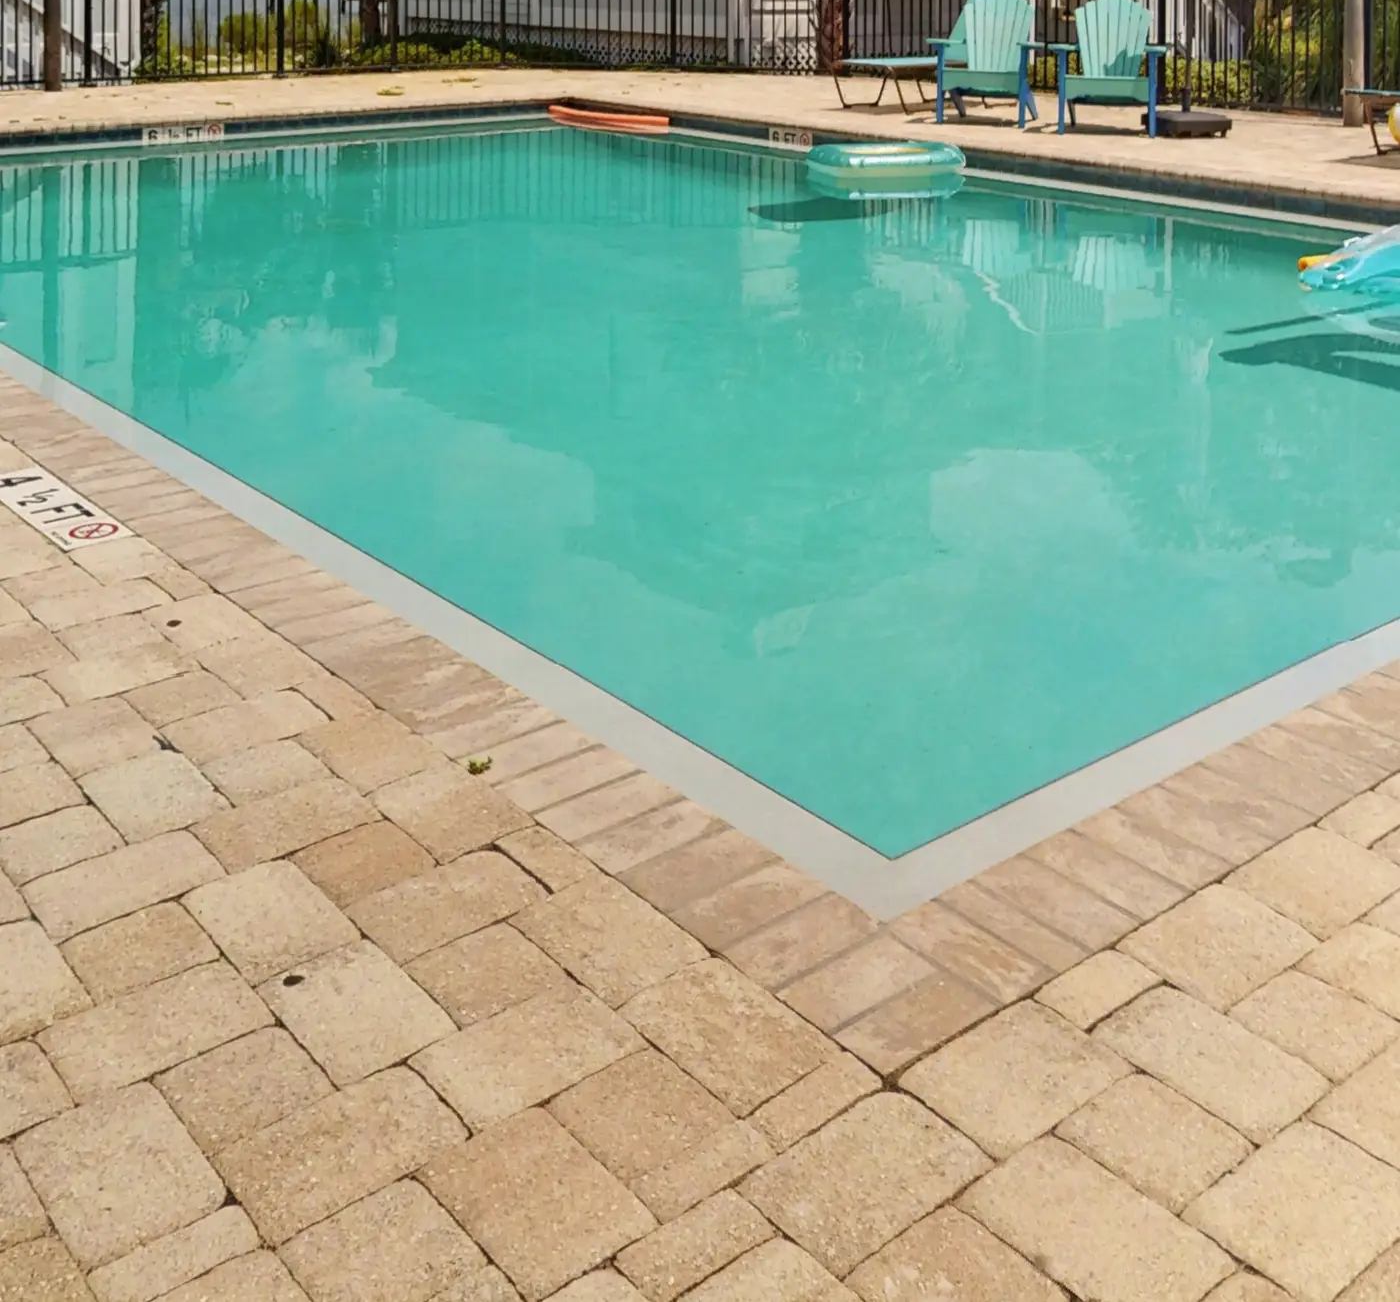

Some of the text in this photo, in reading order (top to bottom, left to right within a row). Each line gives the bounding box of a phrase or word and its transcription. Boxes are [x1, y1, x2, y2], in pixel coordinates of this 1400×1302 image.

[186, 126, 202, 140] FT
[784, 132, 797, 144] FT
[30, 502, 96, 524] FT
